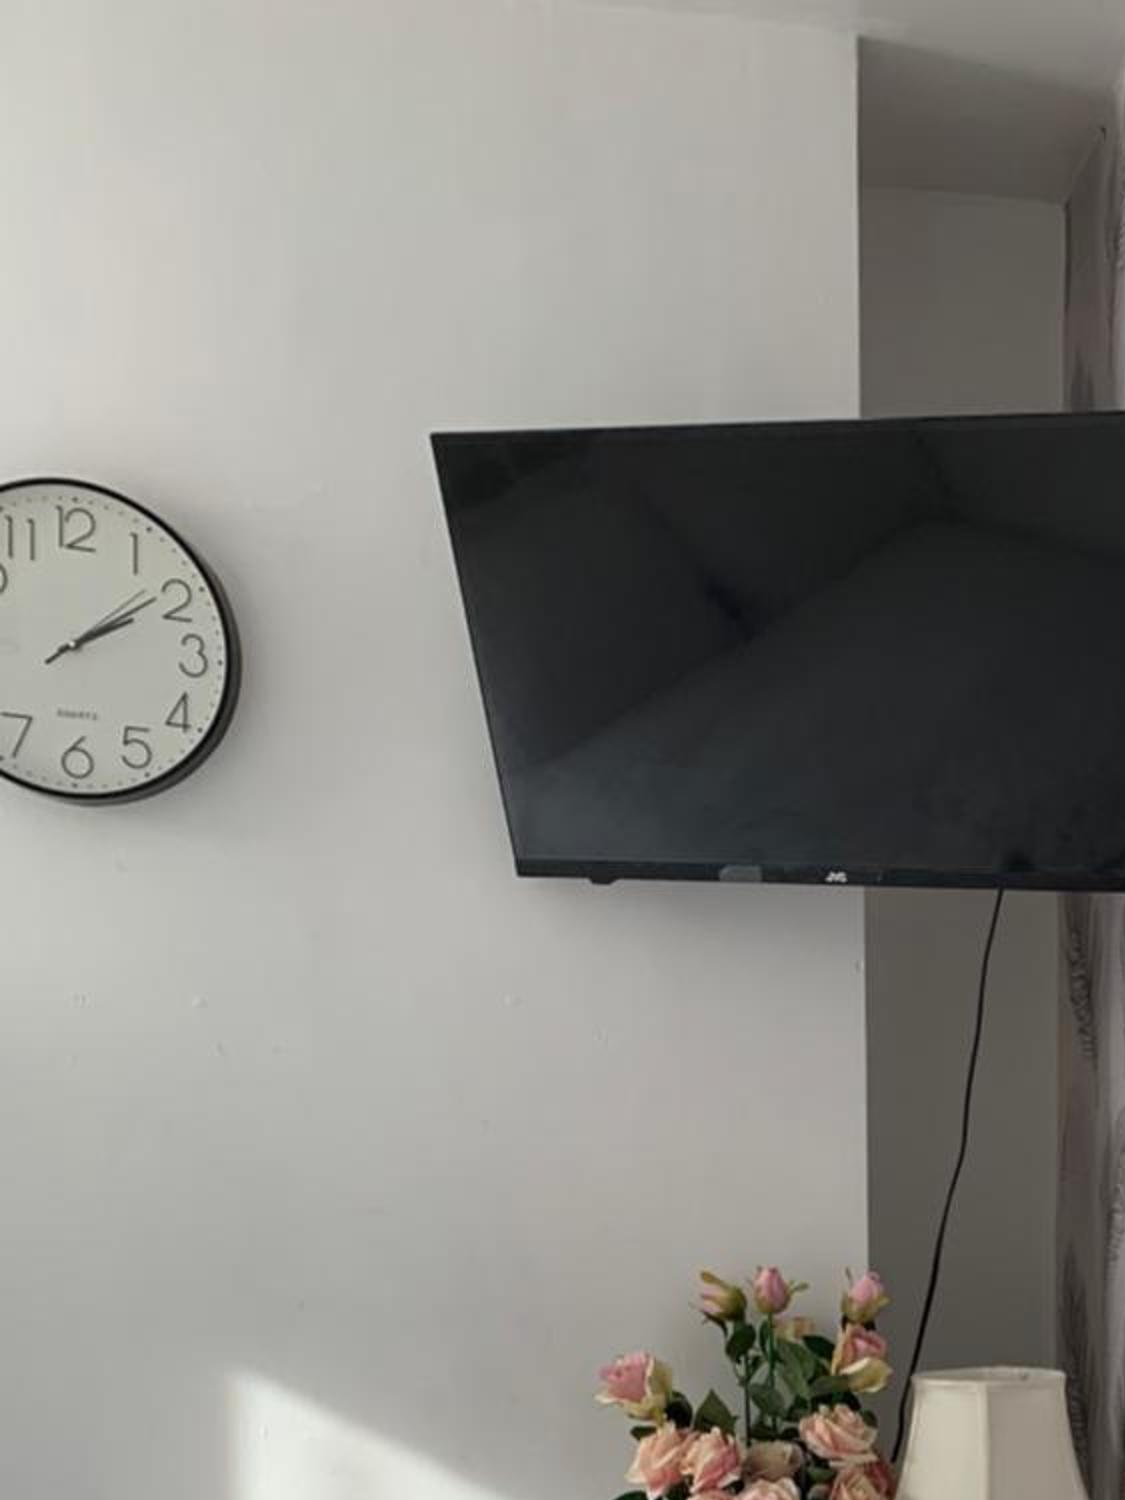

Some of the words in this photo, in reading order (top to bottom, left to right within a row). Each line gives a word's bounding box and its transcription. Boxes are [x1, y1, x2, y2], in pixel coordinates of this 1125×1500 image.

[4, 514, 36, 562] 11
[56, 504, 97, 554] 12
[130, 532, 140, 576] 1
[160, 577, 194, 624] 2
[178, 632, 209, 679] 3
[0, 710, 33, 759] 7
[164, 691, 192, 733] 4
[60, 735, 95, 780] 6
[121, 724, 153, 770] 5
